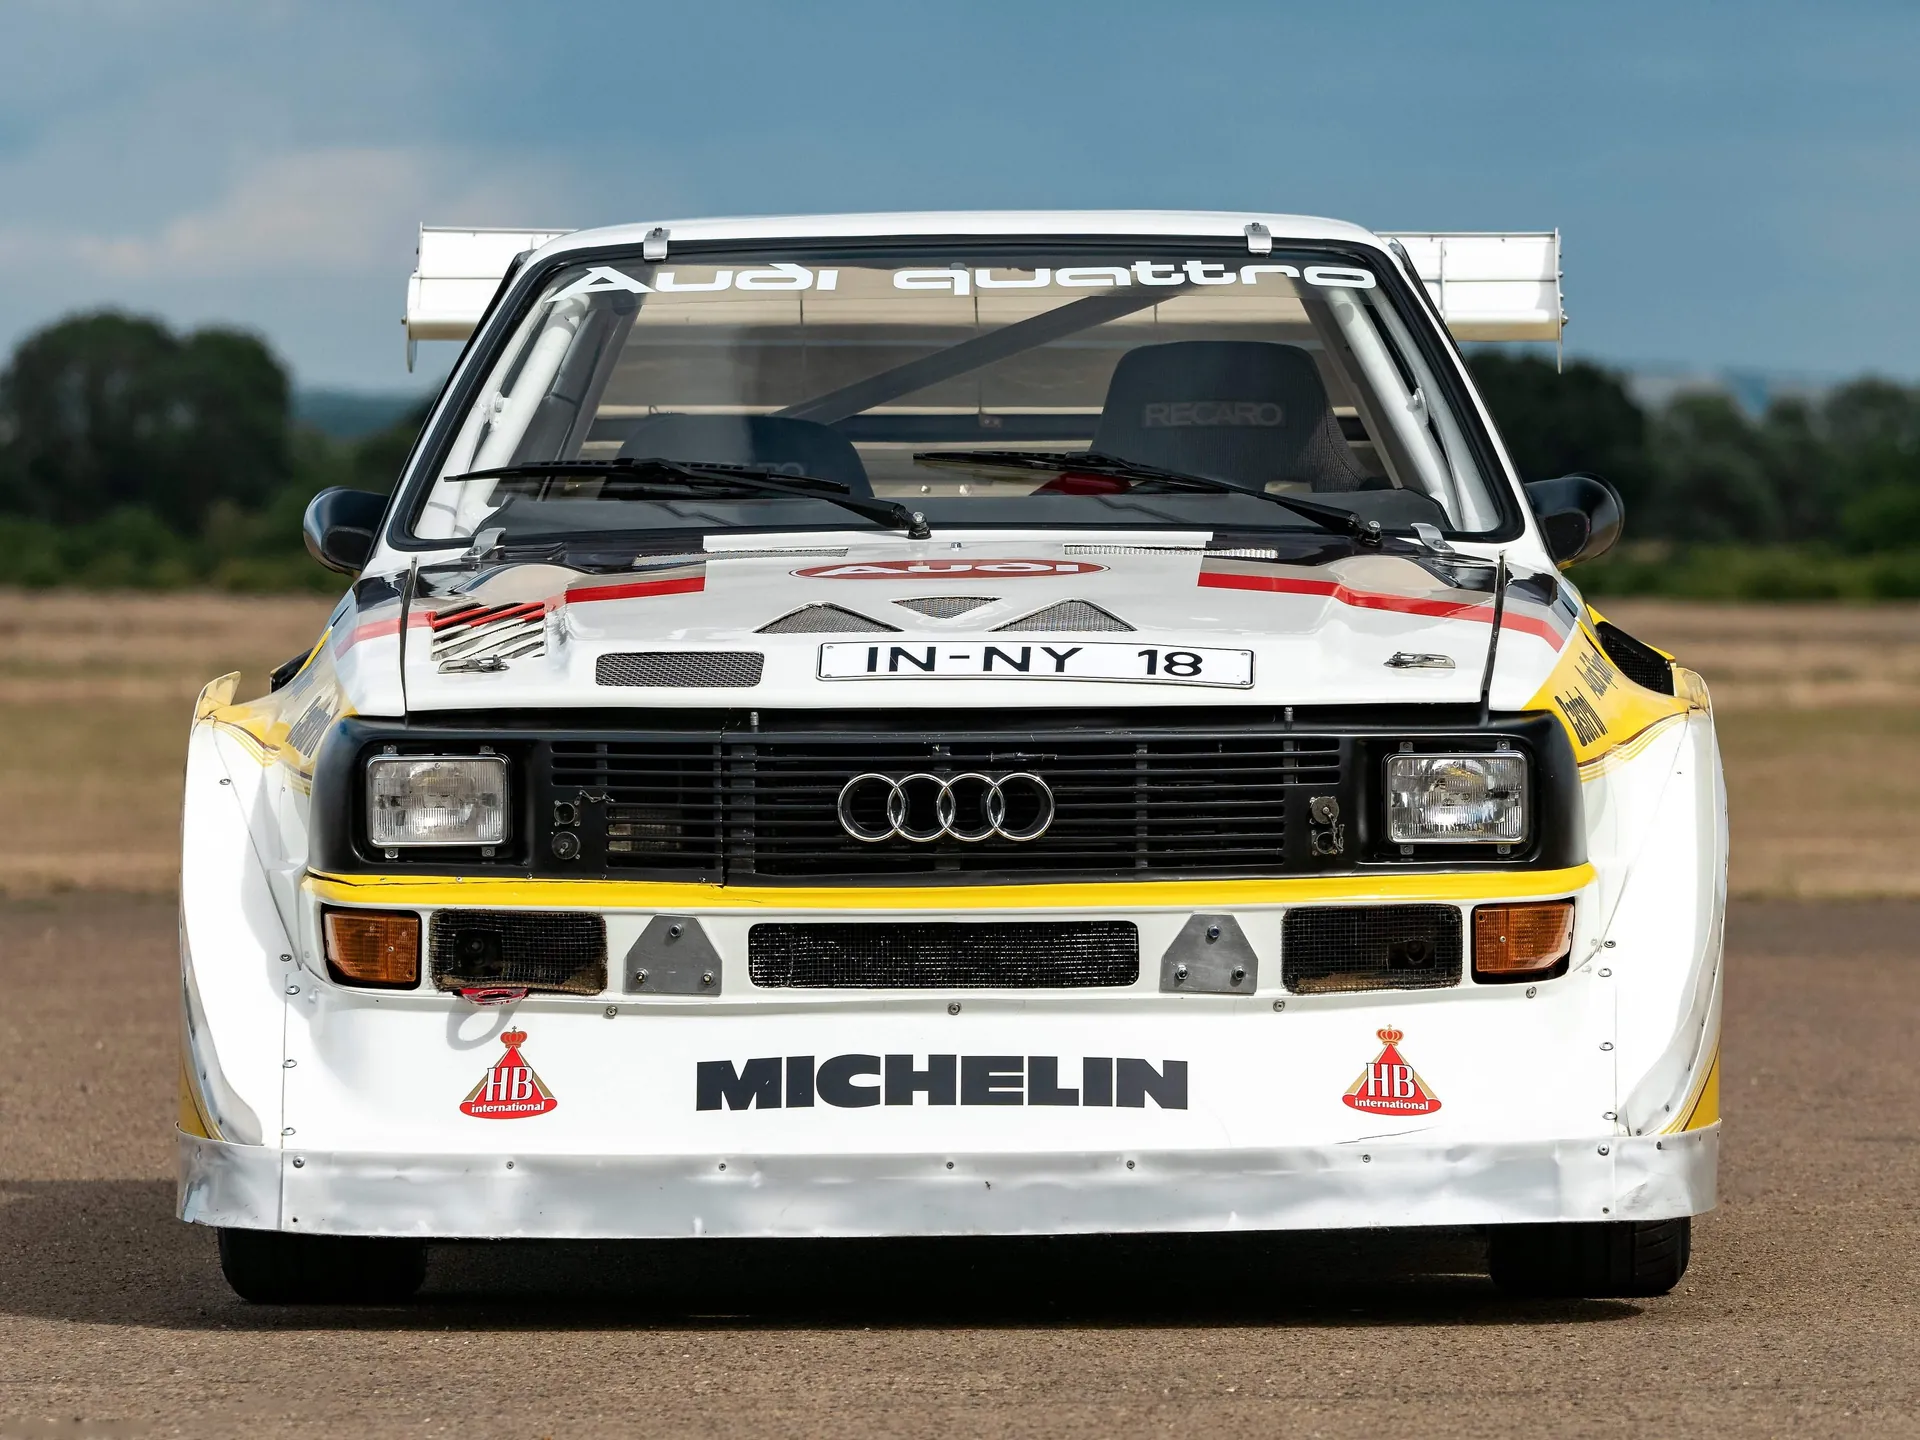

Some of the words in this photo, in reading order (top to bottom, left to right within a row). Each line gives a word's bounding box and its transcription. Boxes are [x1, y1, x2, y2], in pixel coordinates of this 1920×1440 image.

[543, 263, 839, 303] Audi
[893, 260, 1377, 295] quattro
[1145, 402, 1283, 427] RECARO
[1137, 649, 1203, 677] 18
[1554, 686, 1608, 747] Castrol
[485, 1066, 534, 1102] HB
[696, 1054, 1189, 1111] MICHELIN
[1366, 1062, 1416, 1099] HB
[471, 1101, 545, 1113] international
[1354, 1097, 1429, 1110] international
